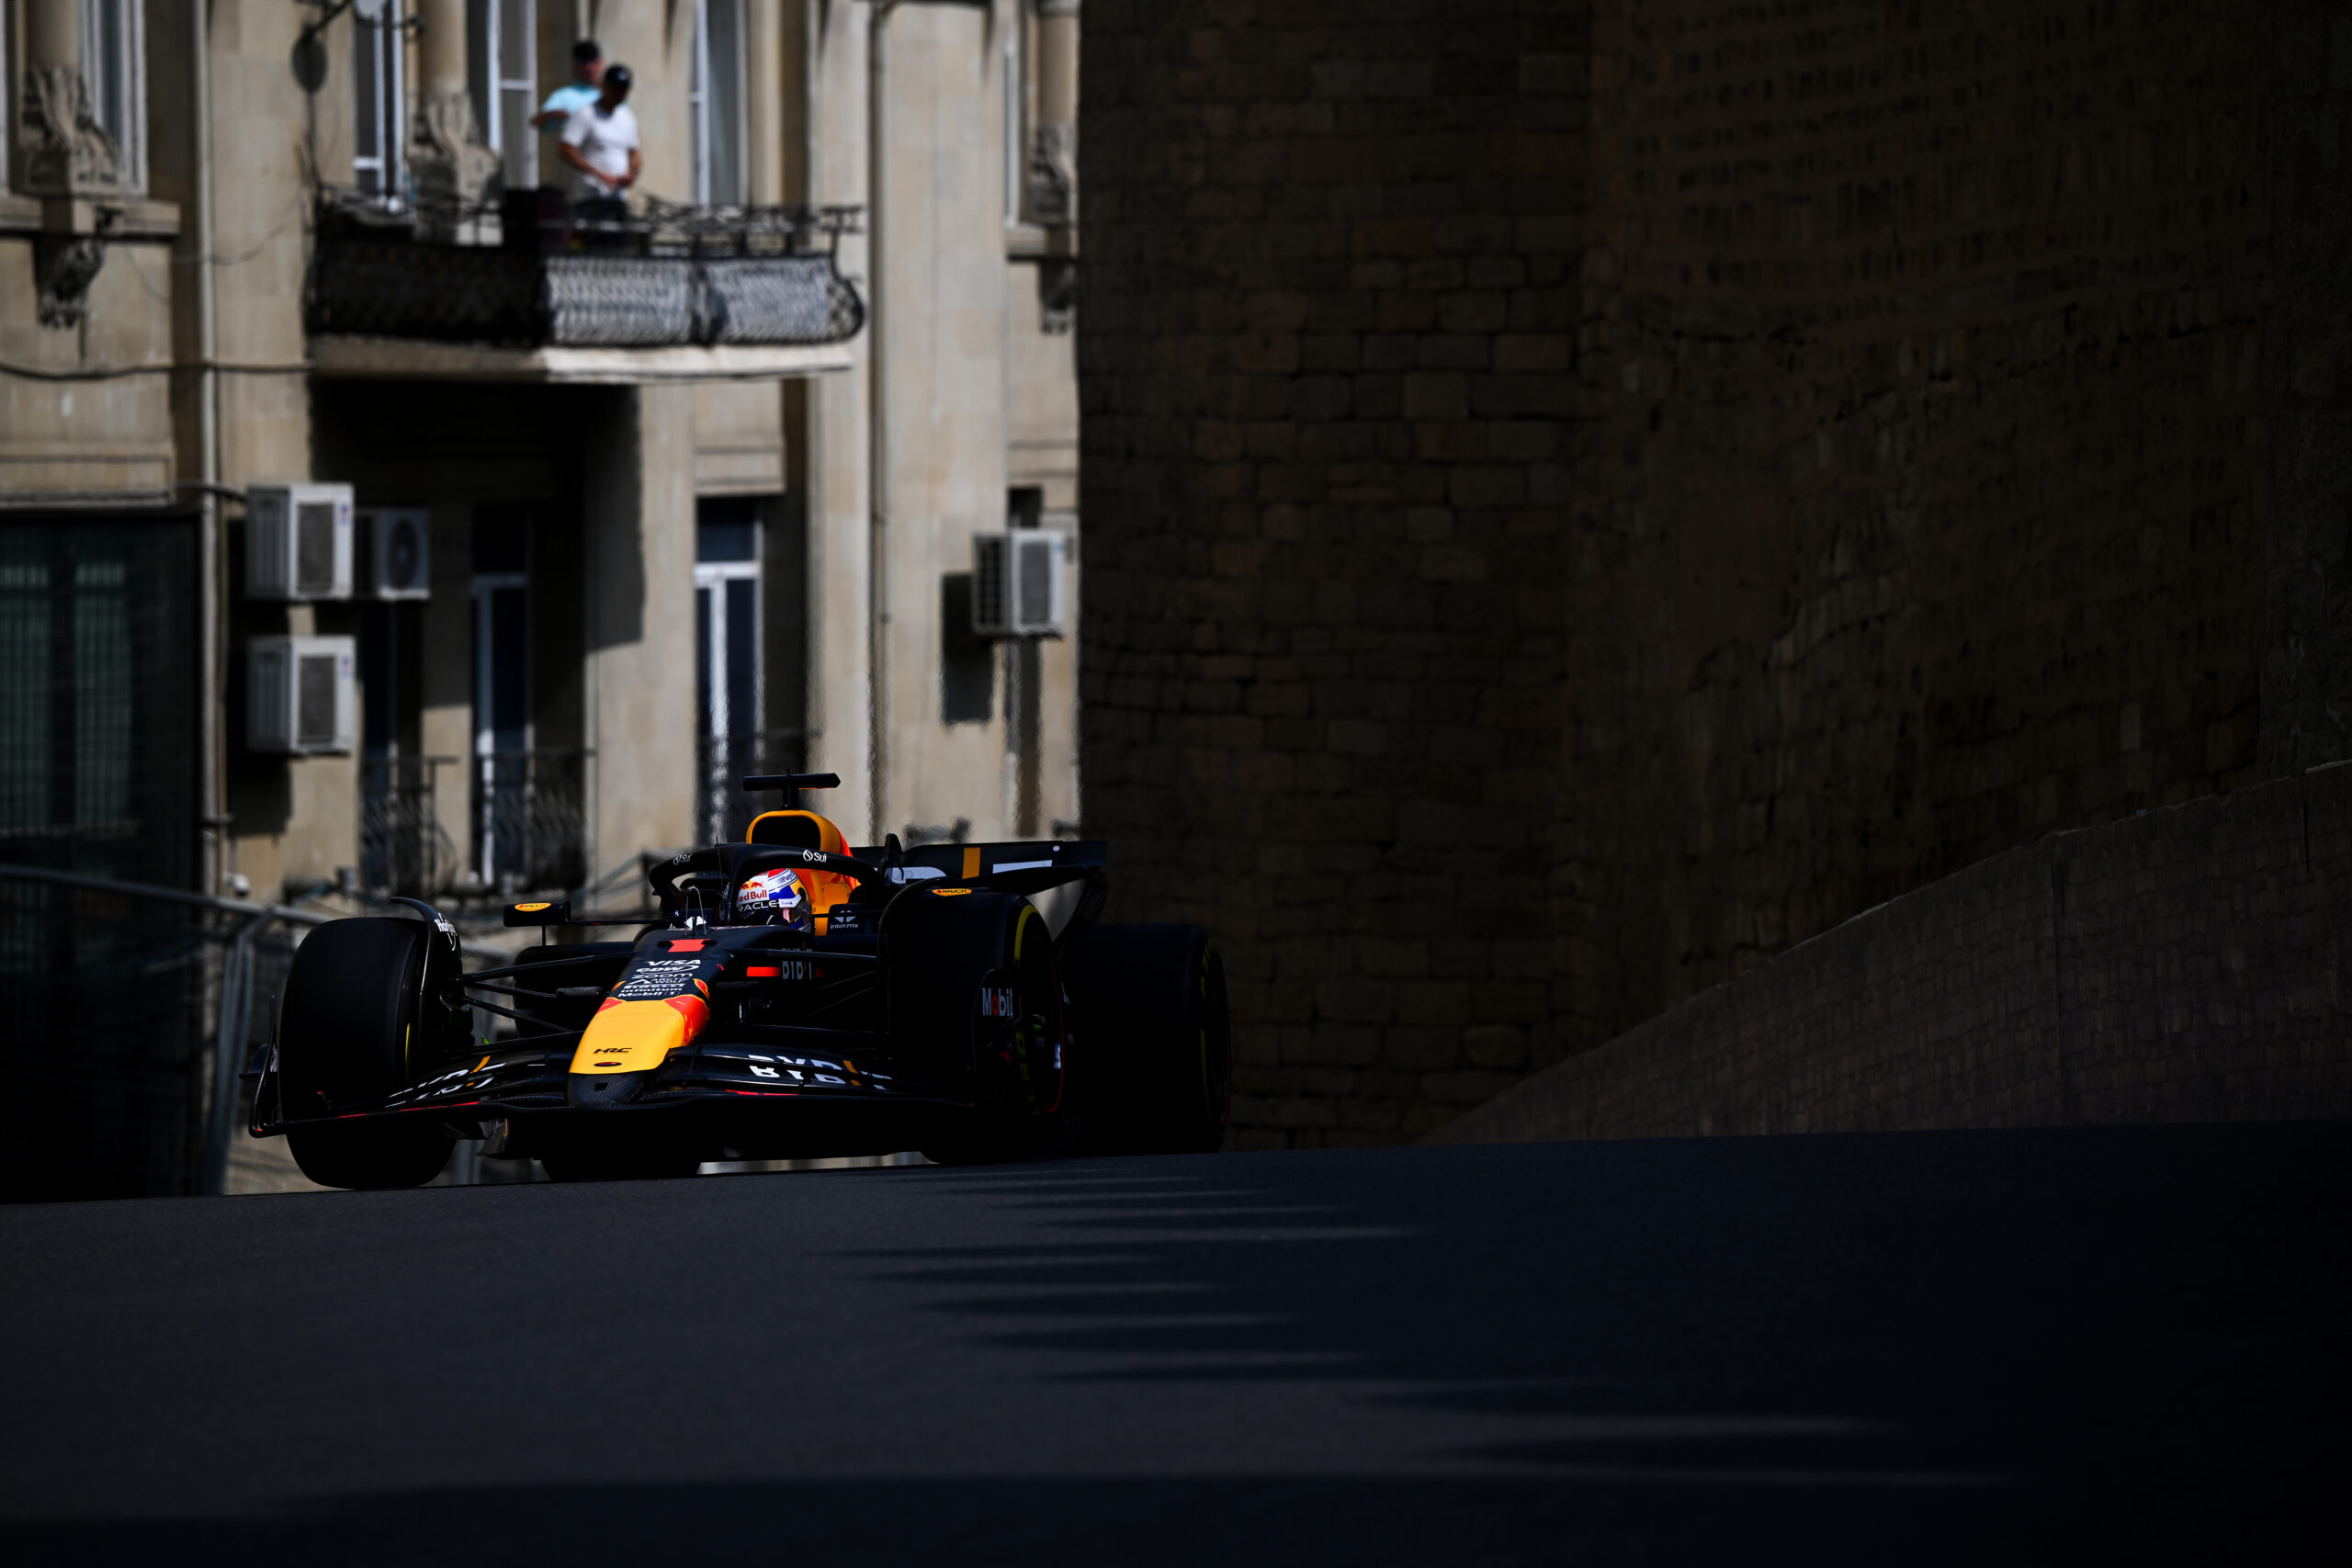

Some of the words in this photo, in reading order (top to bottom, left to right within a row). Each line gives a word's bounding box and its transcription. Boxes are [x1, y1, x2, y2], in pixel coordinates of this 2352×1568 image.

[750, 890, 767, 899] Bull
[738, 899, 779, 912] RACLE
[981, 987, 1014, 1018] Mobil
